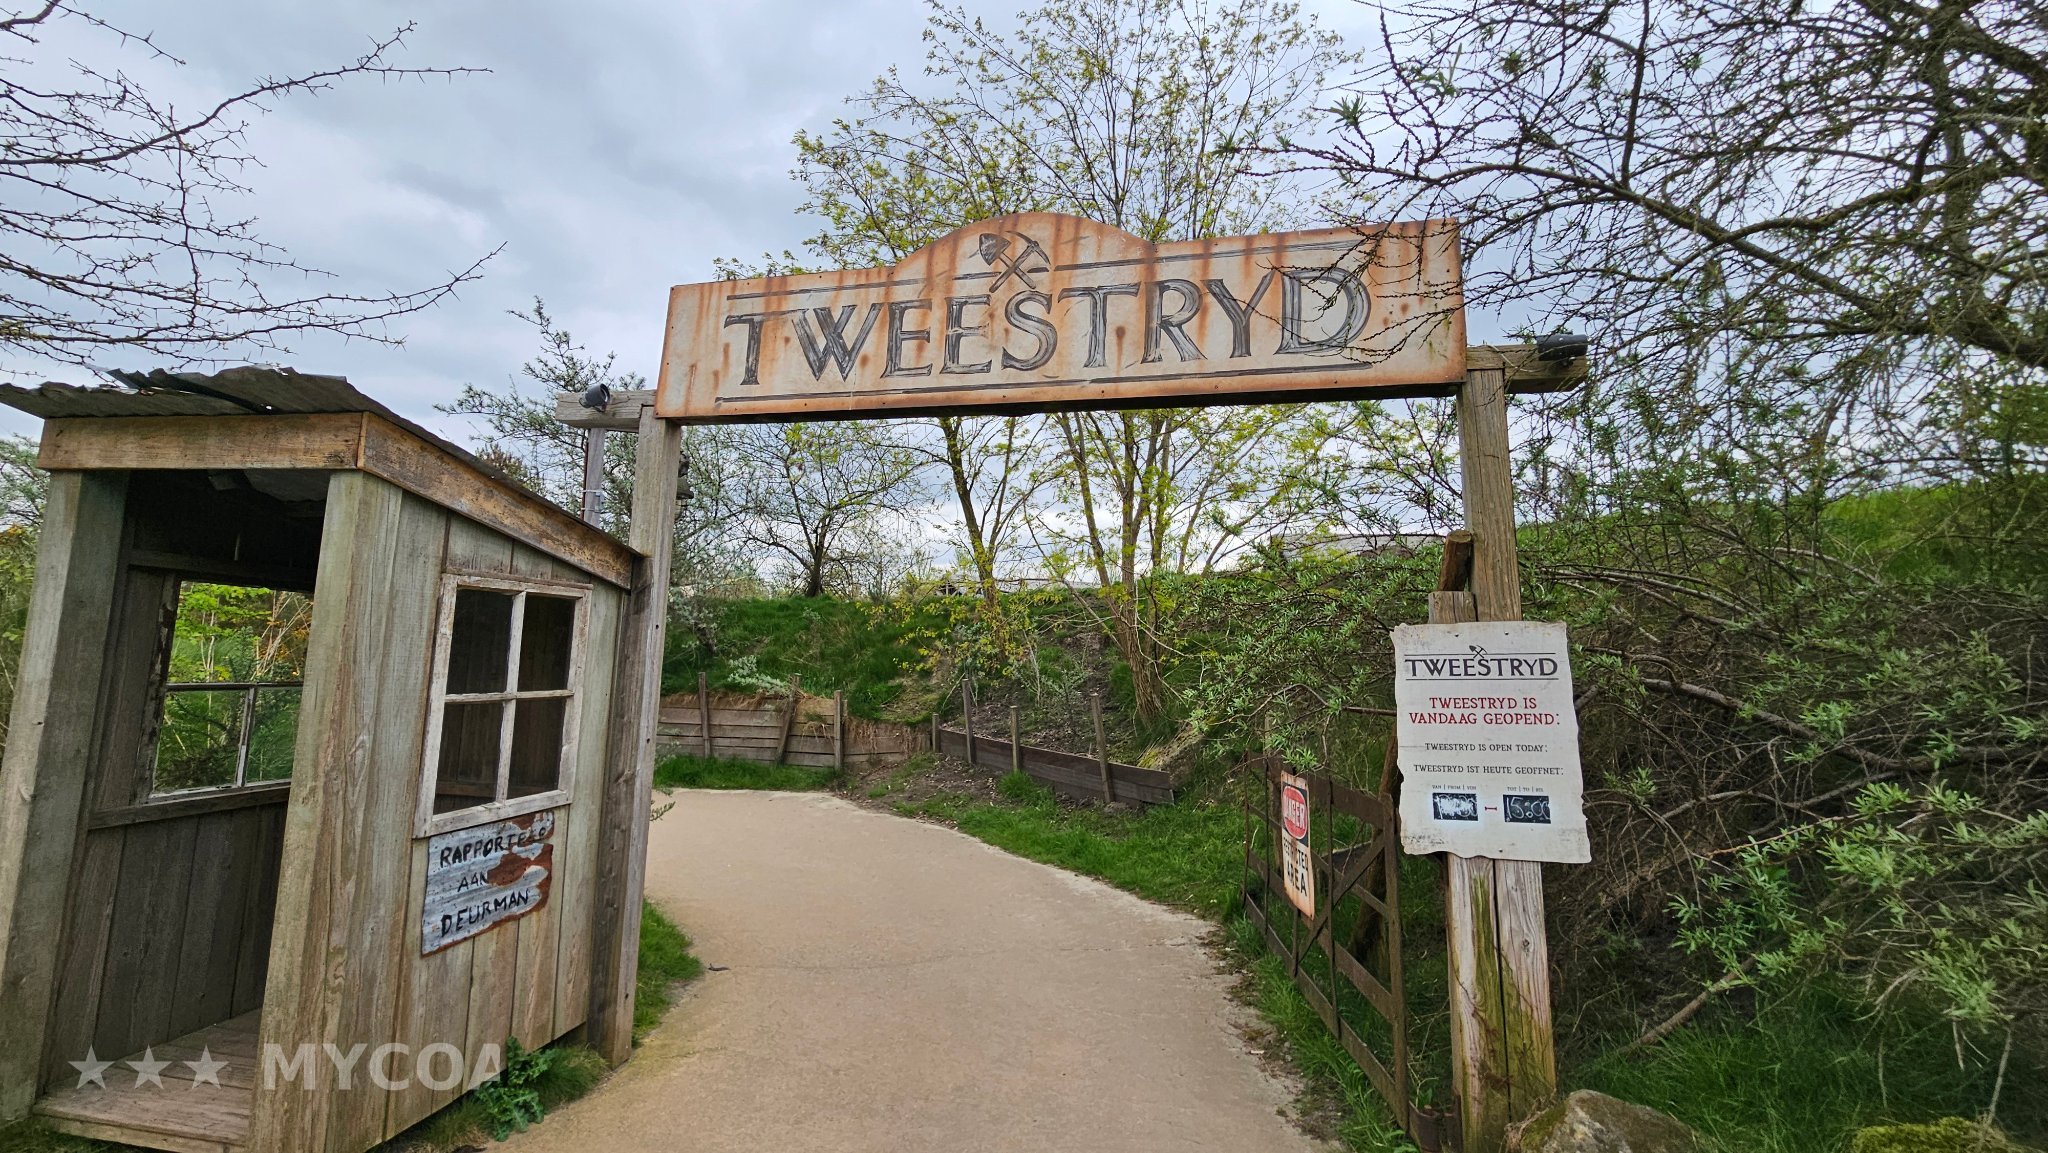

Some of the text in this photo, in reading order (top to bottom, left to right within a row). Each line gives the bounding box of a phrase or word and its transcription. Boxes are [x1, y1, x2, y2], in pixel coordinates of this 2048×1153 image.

[724, 266, 1371, 386] TWEESTRYD
[1404, 658, 1558, 677] TWEESTRYD
[1429, 697, 1537, 710] TWEESTRYD IS
[1409, 712, 1477, 725] VANDAAG
[1424, 742, 1476, 752] TWEESTRYD
[1478, 743, 1487, 752] IS
[1489, 743, 1513, 752] OPEN
[1413, 764, 1464, 773] TWEESTRYD
[1466, 765, 1480, 774] IST
[1483, 766, 1513, 775] HEUTE
[457, 870, 489, 892] AAN
[441, 888, 531, 938] DEURMAN
